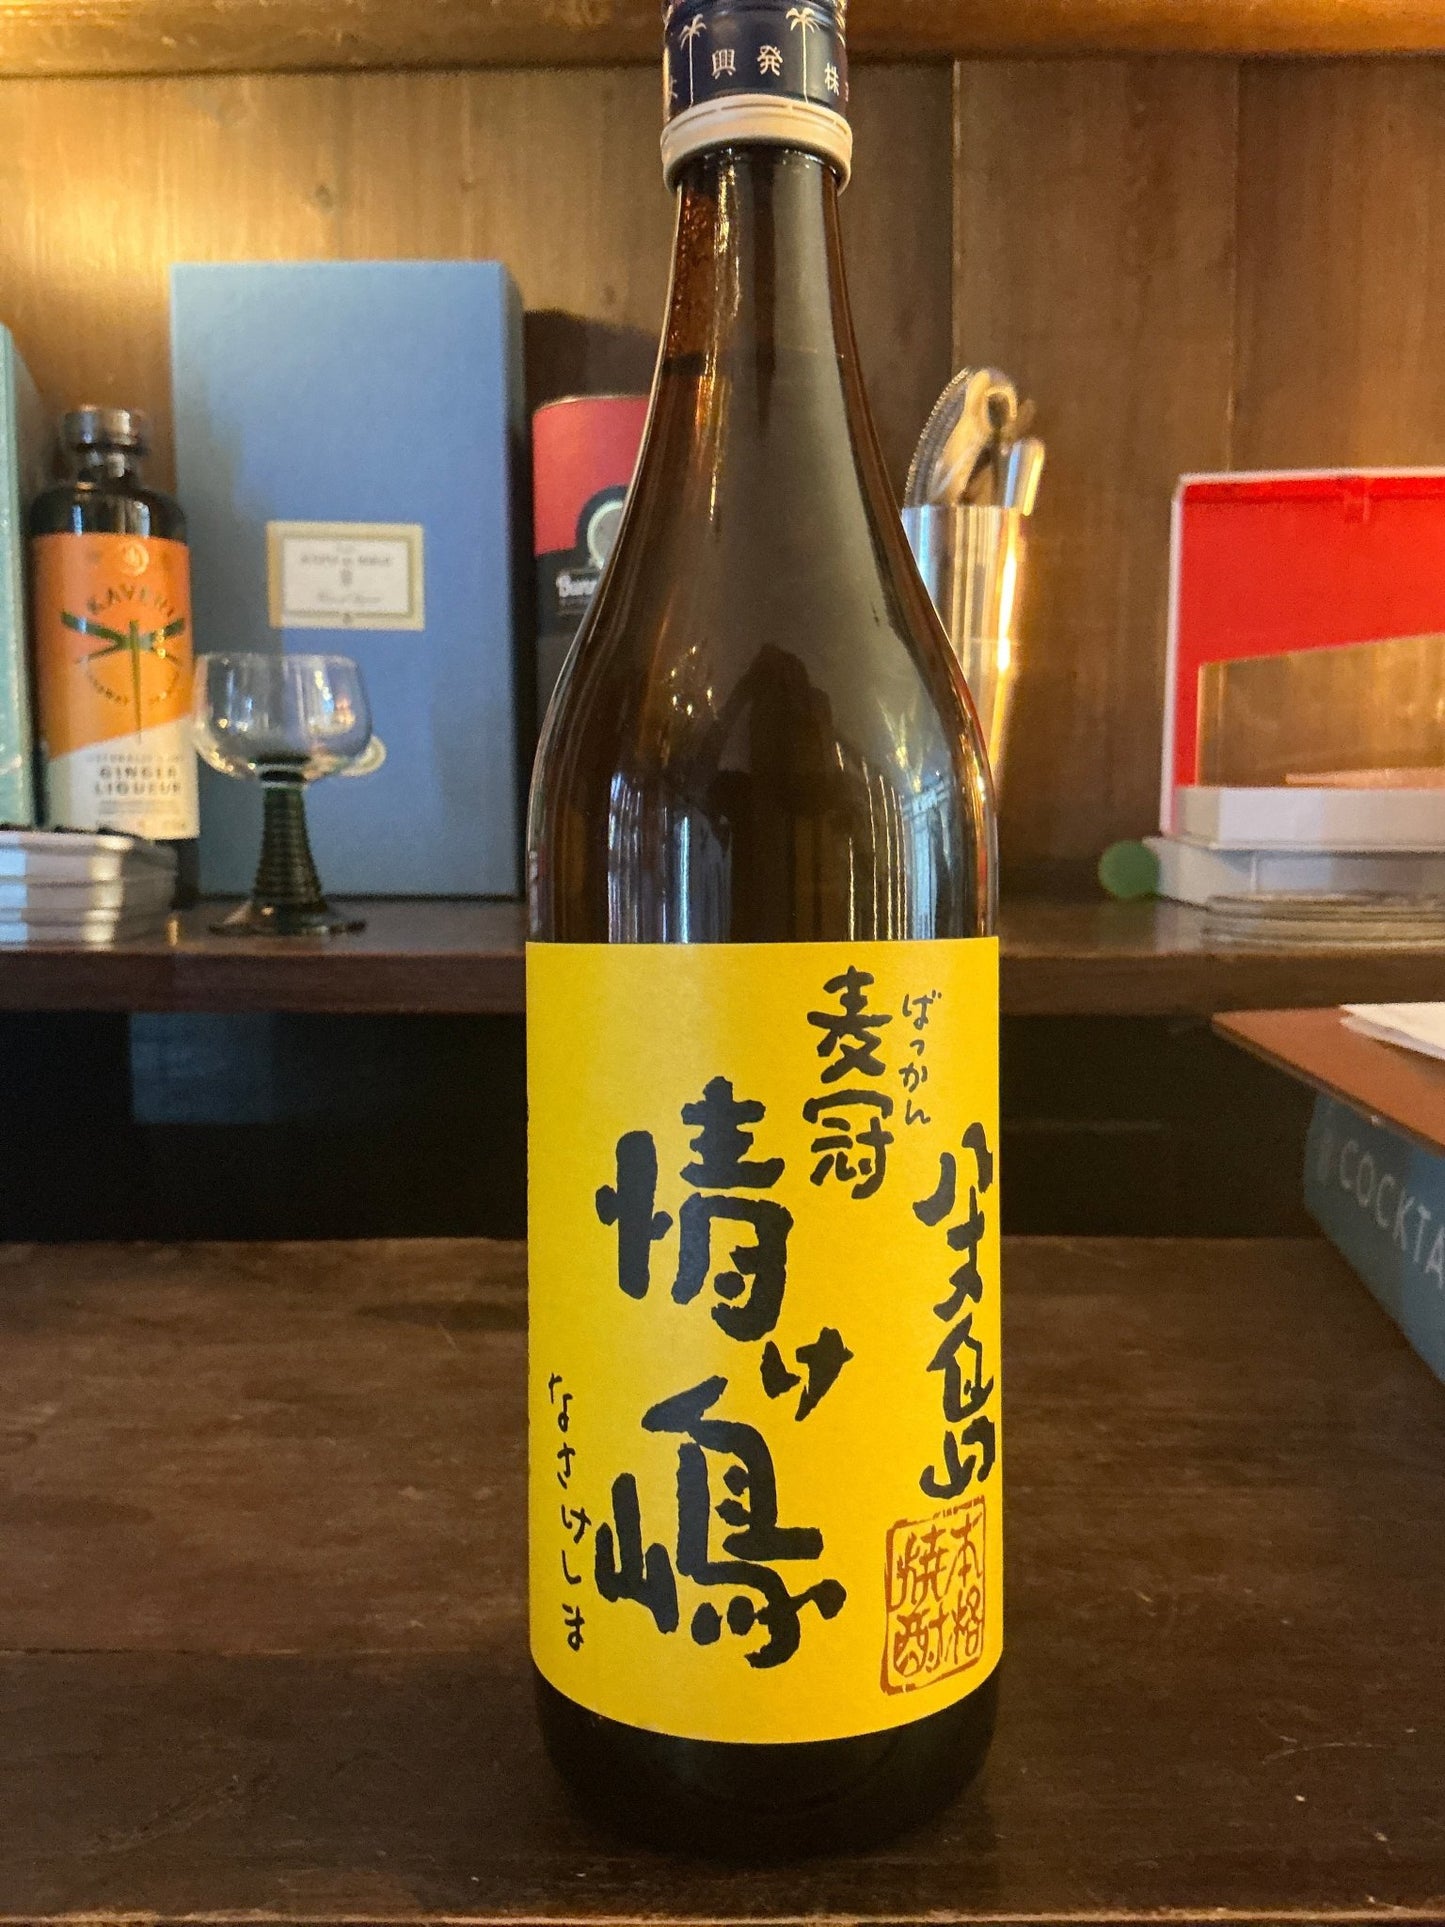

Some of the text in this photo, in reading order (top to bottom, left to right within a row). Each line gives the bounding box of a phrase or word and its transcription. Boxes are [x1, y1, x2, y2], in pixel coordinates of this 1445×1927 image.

[712, 45, 784, 80] 興発
[803, 965, 894, 1200] 麦冠
[898, 989, 942, 1126] ばっかん
[1338, 1138, 1445, 1290] COCKTA
[595, 1076, 854, 1669] 情け嶋
[548, 1372, 592, 1653] なさけしま
